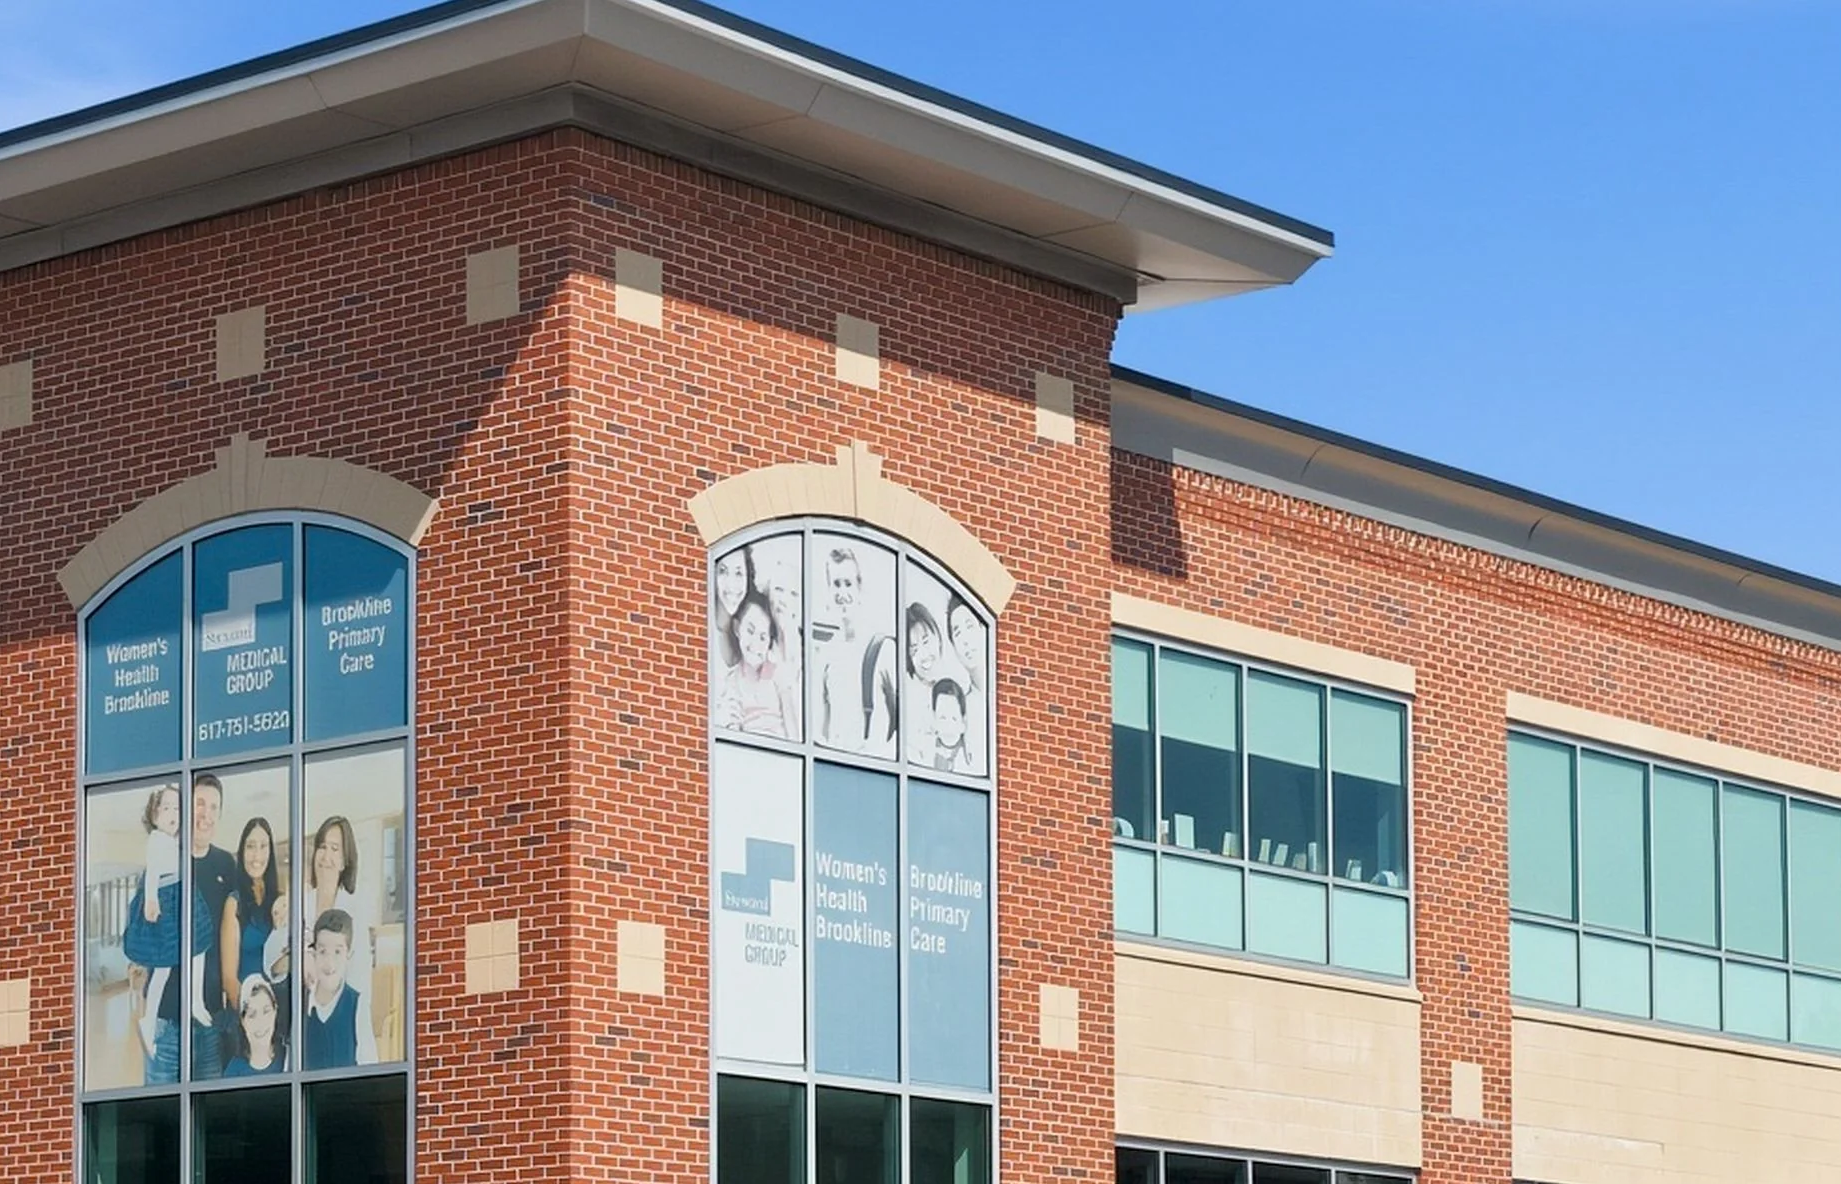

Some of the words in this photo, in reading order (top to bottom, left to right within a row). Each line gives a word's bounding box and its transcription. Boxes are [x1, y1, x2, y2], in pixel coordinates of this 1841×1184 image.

[321, 596, 392, 626] Brookline
[106, 637, 169, 664] Women's
[329, 625, 386, 651] Primary
[226, 646, 288, 673] MEDICAL
[340, 653, 375, 675] Care
[114, 664, 159, 687] Health
[226, 669, 274, 695] GROUP
[104, 688, 170, 715] Brookline
[815, 851, 887, 886] Women's
[910, 865, 983, 899] Brookline
[815, 882, 868, 913] Health
[910, 896, 970, 932] Primary
[744, 922, 799, 947] MEDICAL
[816, 914, 892, 949] Brookline
[910, 926, 947, 954] Care
